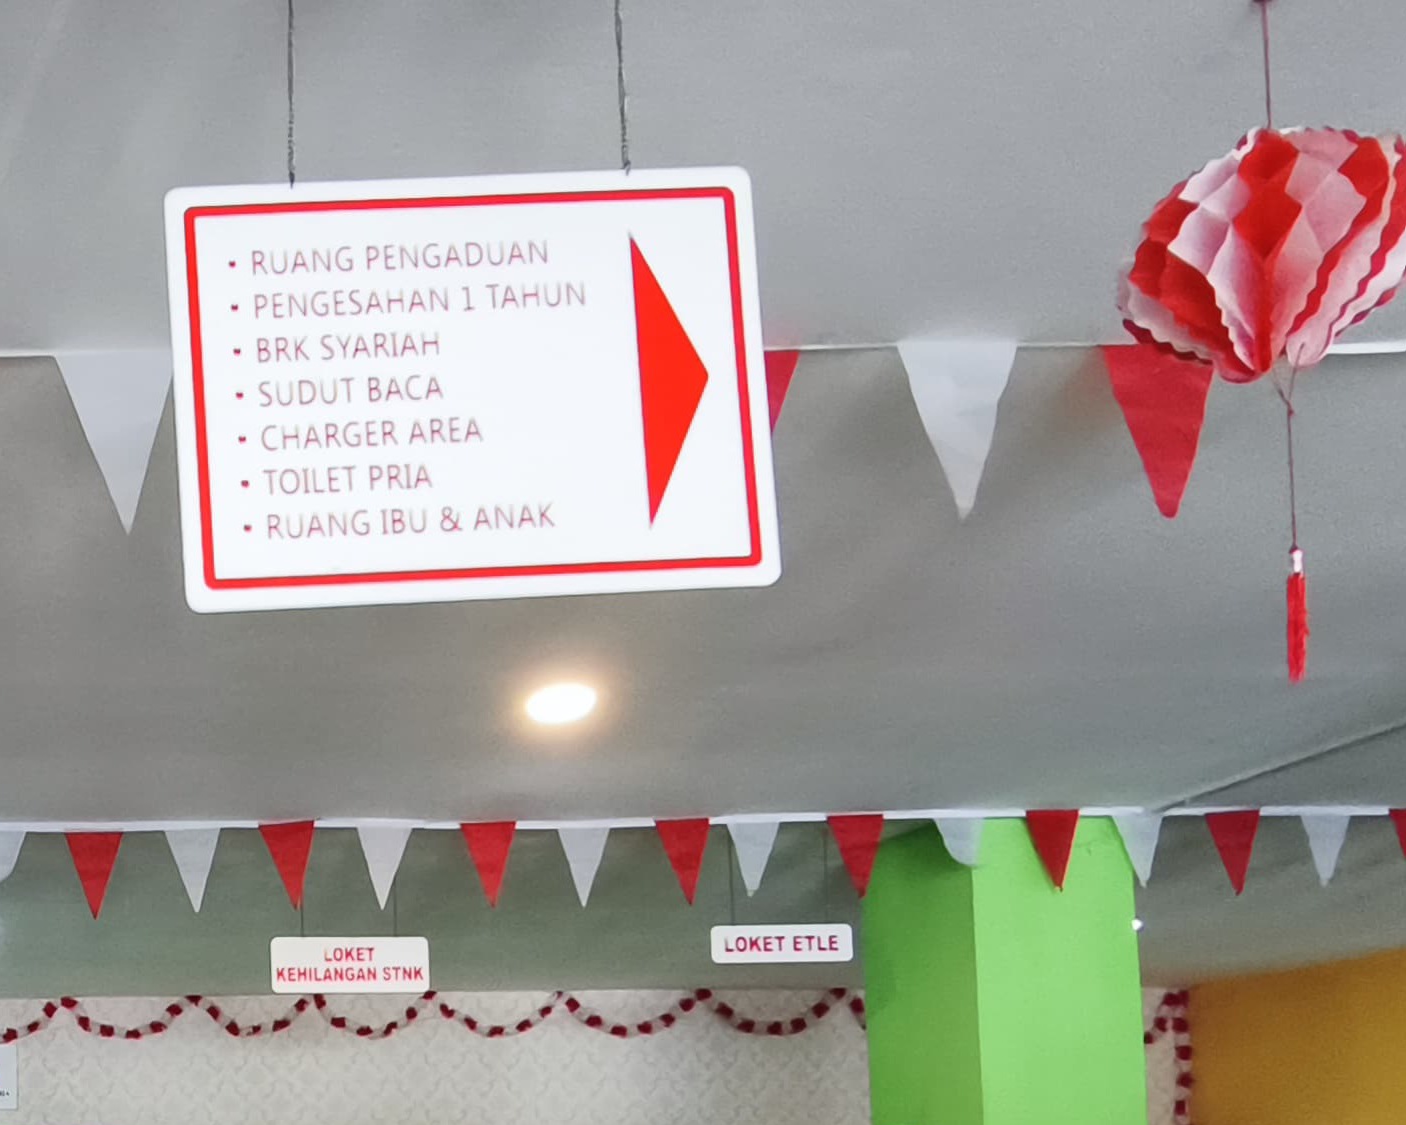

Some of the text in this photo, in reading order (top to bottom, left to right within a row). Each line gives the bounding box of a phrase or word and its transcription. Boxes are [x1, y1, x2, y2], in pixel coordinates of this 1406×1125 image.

[252, 240, 548, 275] RUANG PENGADUAN
[254, 283, 585, 319] PENGESAHAN 1 TAHUN
[257, 332, 439, 363] BRK SYARIAH
[258, 375, 443, 407] SUDUT BACA
[261, 417, 483, 451] CHARGER AREA
[263, 464, 432, 495] TOILET PRIA
[267, 504, 555, 539] RUANG IBU & ANAK
[324, 947, 375, 962] LOKET
[724, 935, 839, 952] LOKET ETLE
[276, 966, 424, 982] KEHILANGAN STNK
